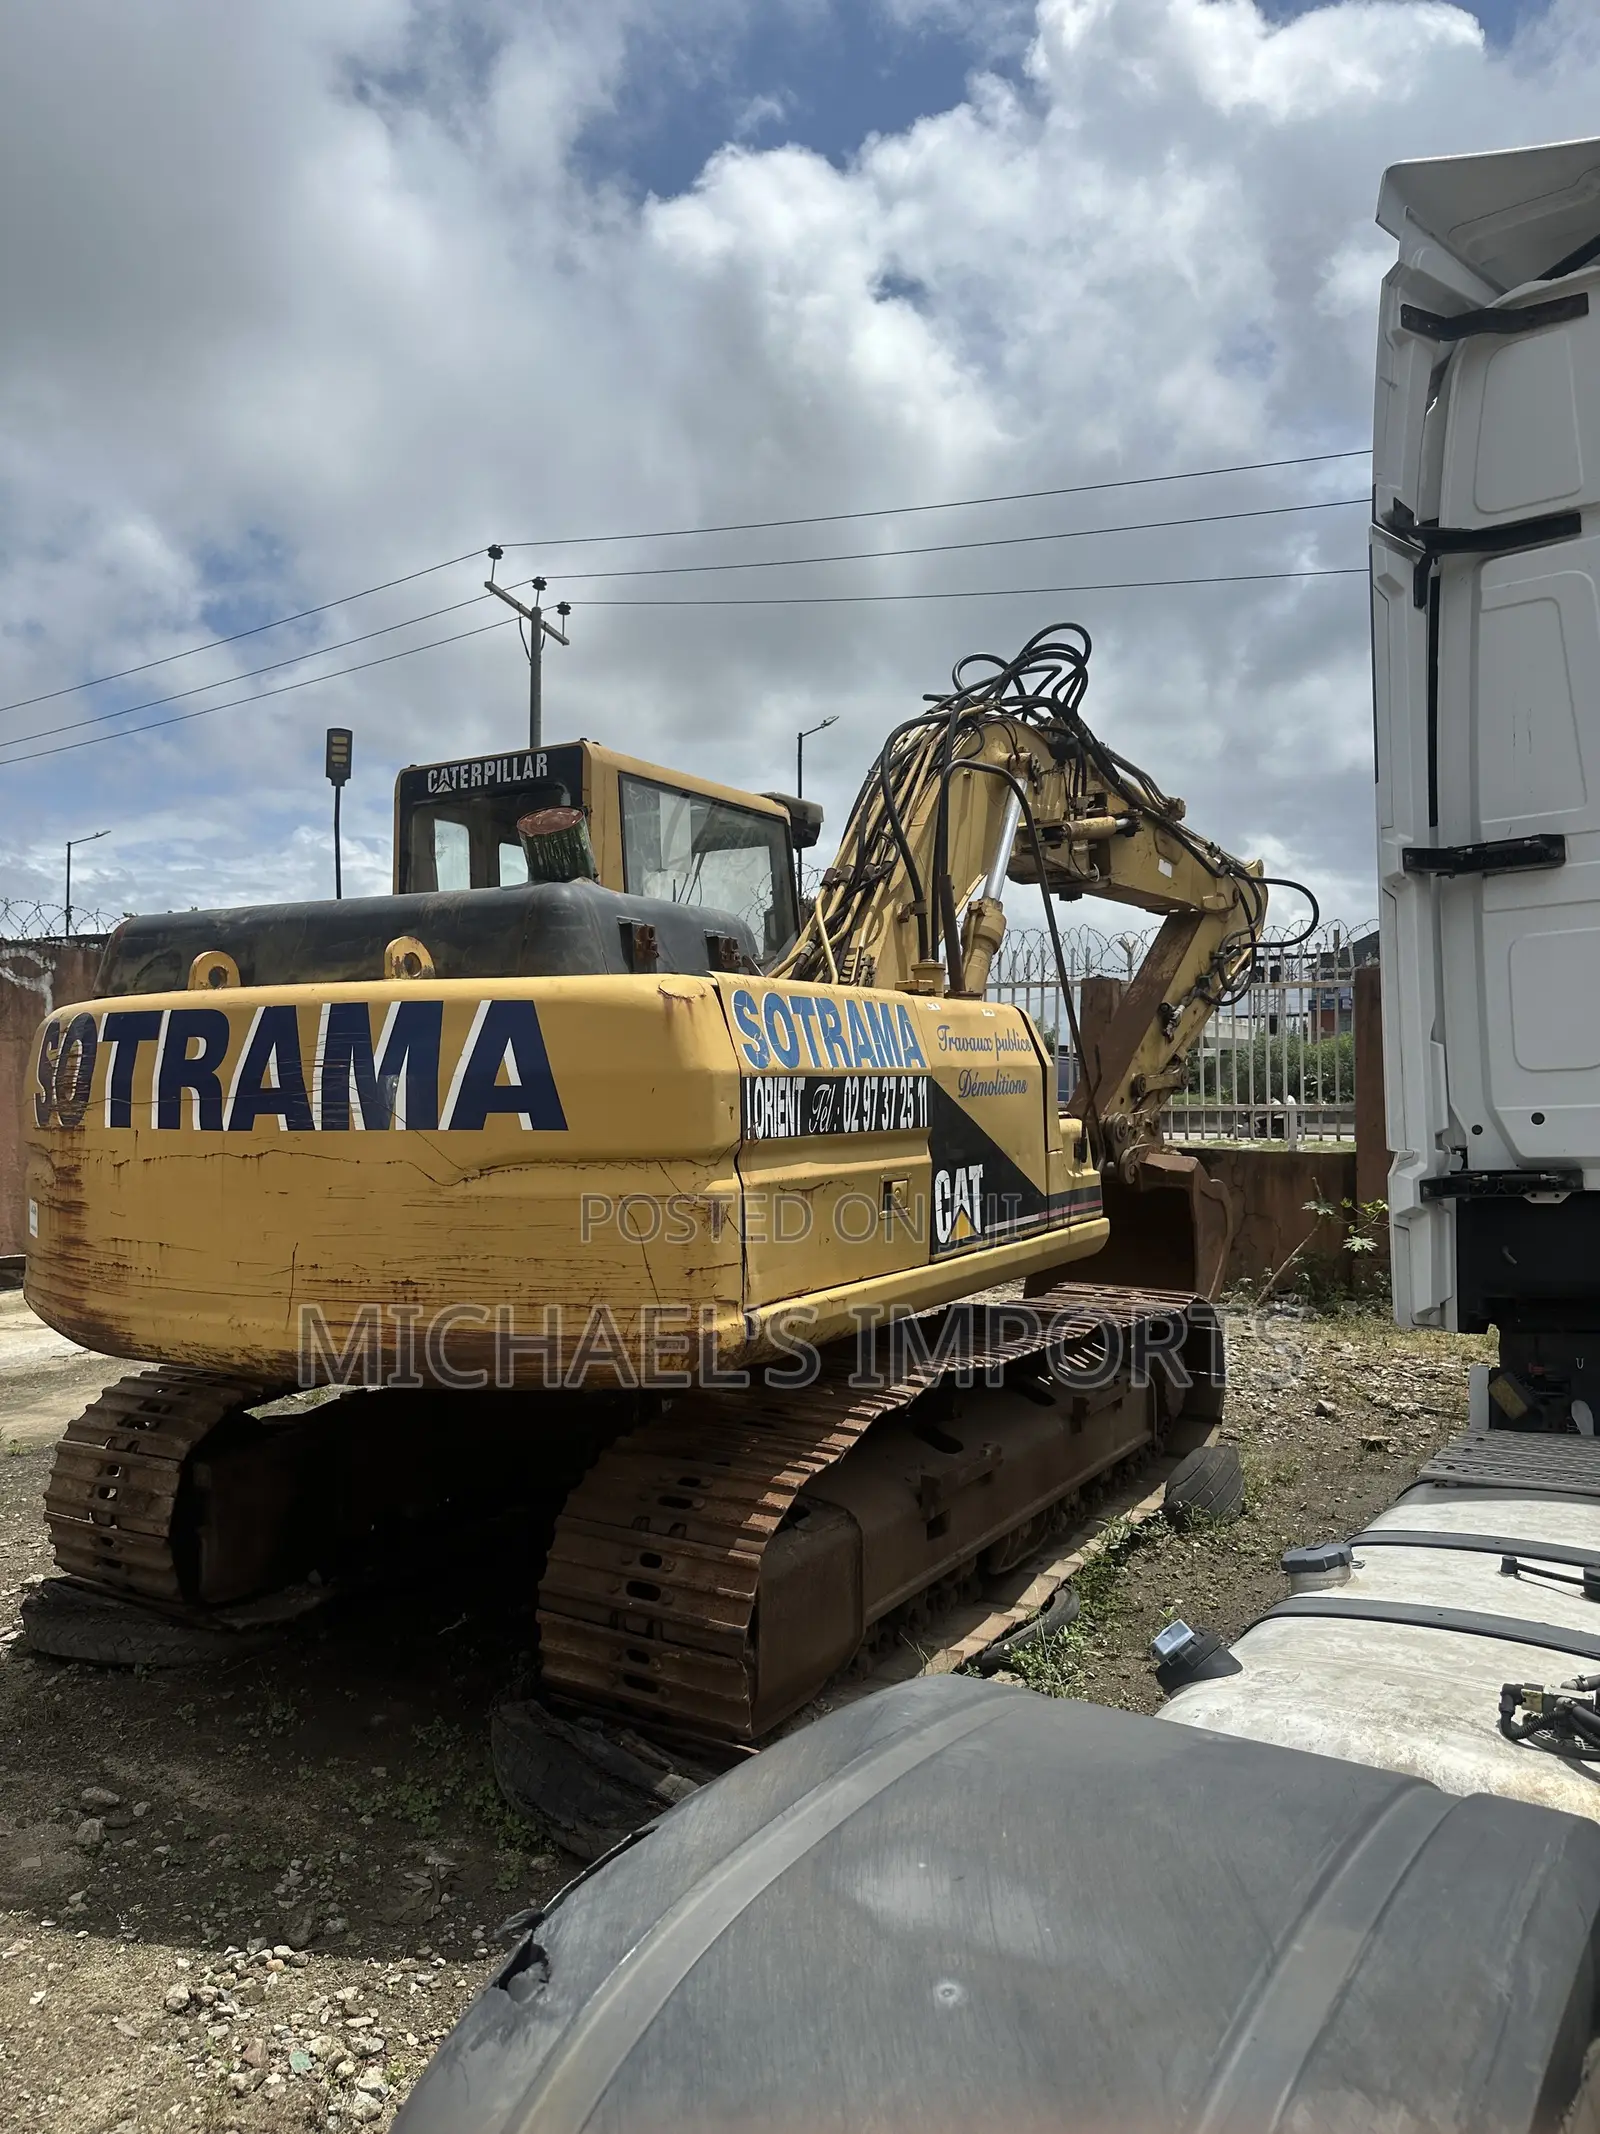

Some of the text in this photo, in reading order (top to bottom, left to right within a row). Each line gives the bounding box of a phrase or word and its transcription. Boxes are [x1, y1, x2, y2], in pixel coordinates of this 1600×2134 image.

[427, 752, 548, 793] CATERPILLAR
[731, 989, 927, 1070] SOTRAMA
[936, 1024, 993, 1053] Travaux
[33, 1000, 569, 1132] SOTRAMA
[957, 1068, 1028, 1098] Démolitions
[843, 1075, 859, 1133] 02
[863, 1076, 878, 1132] 97
[881, 1076, 896, 1131] 37
[900, 1076, 914, 1130] 25
[917, 1076, 928, 1128] 11
[934, 1163, 984, 1244] CAT
